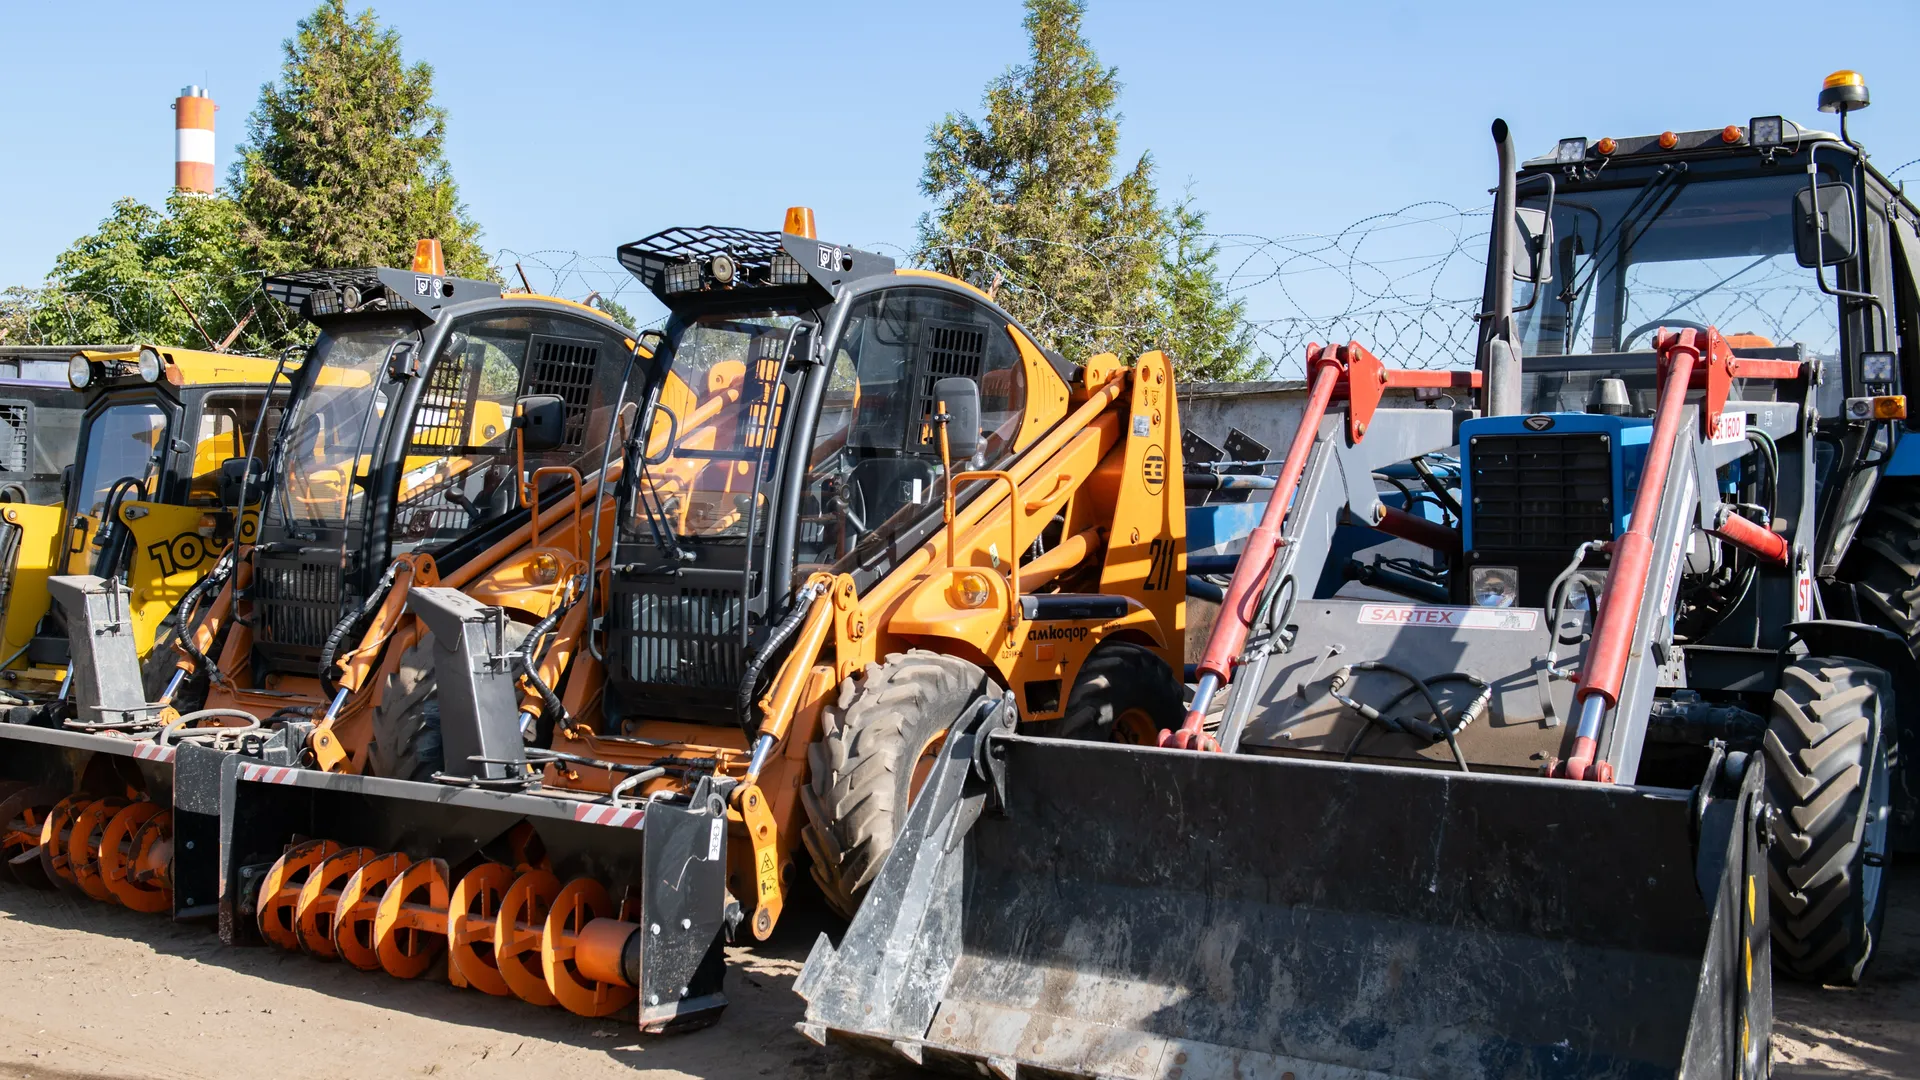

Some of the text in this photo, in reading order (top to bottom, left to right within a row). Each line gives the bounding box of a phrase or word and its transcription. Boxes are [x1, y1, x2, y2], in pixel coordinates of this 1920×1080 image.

[1725, 417, 1740, 438] 1600
[1143, 538, 1176, 591] 211
[1799, 579, 1810, 612] ST
[1371, 608, 1453, 624] SARTEX
